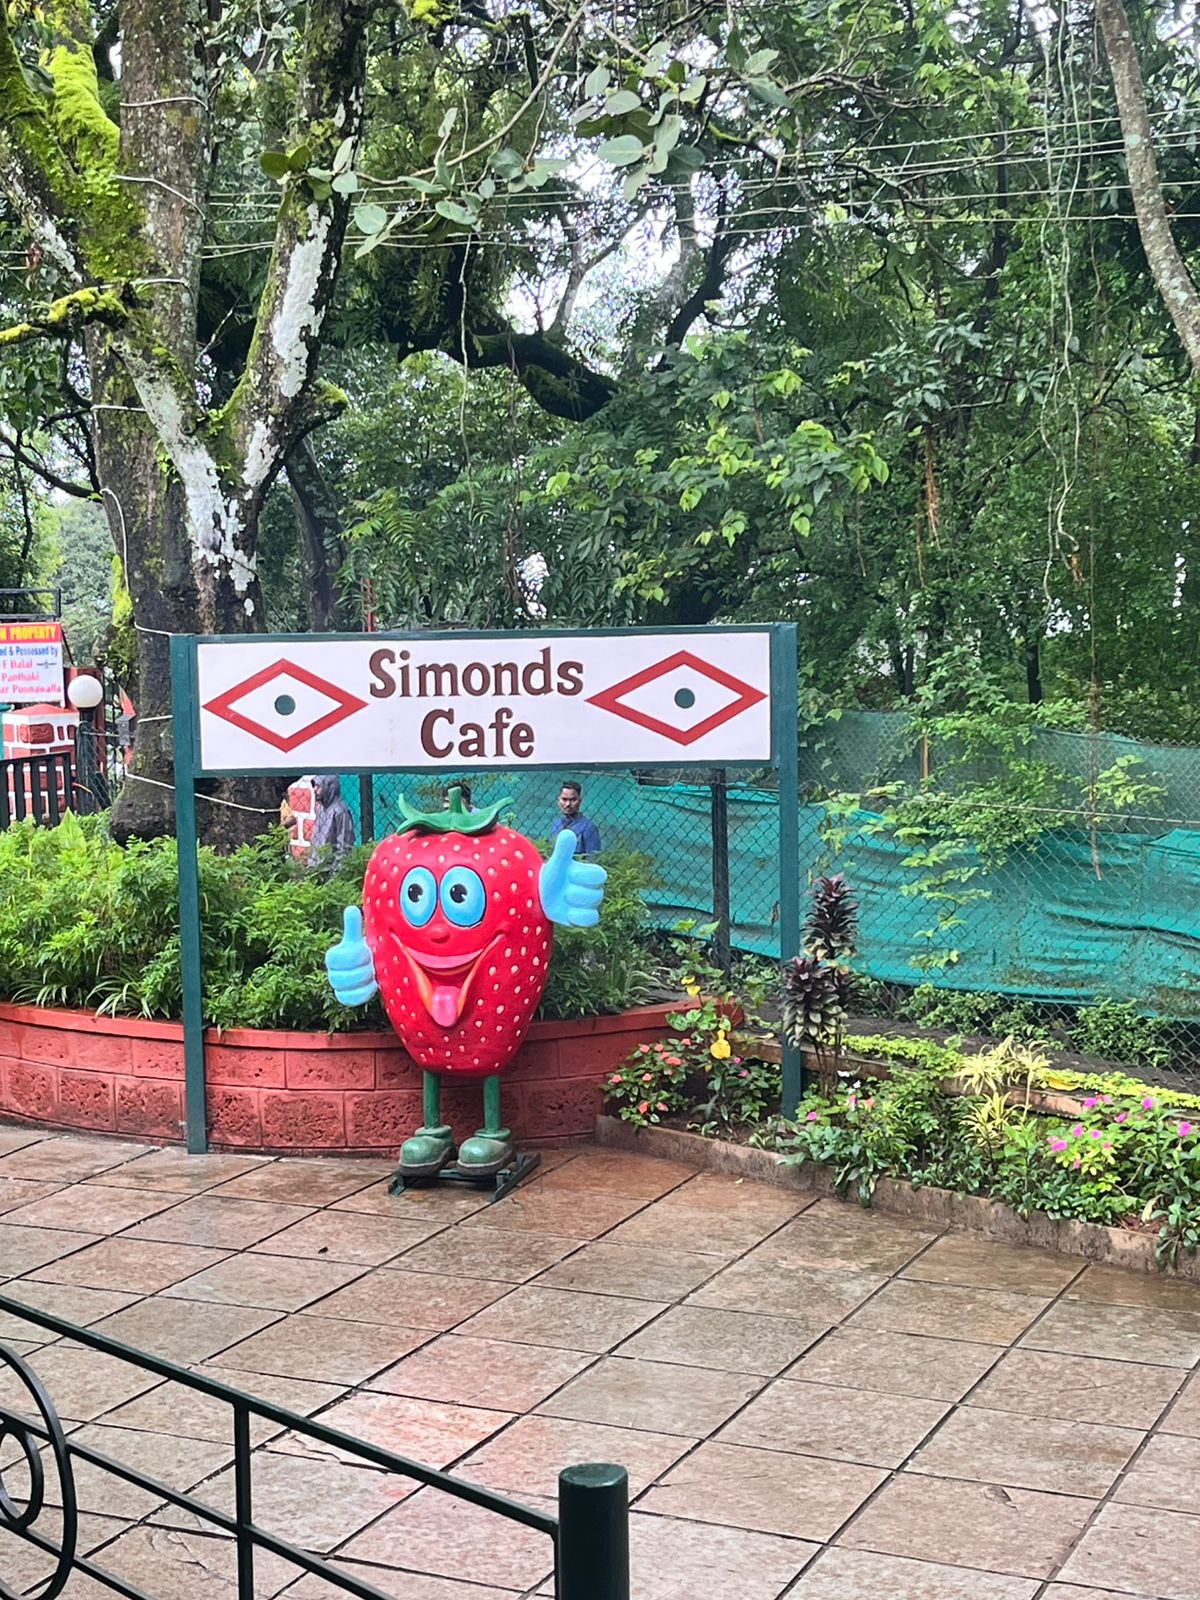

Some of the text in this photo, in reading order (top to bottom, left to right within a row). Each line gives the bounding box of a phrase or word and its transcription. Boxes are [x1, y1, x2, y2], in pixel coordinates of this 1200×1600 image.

[10, 625, 57, 640] PROPERTY
[16, 645, 49, 656] Possessed
[50, 645, 58, 657] by
[11, 659, 33, 669] Dalal
[1, 672, 40, 682] Panthaki
[369, 646, 584, 698] Simonds
[12, 683, 62, 694] Poonawalla
[420, 707, 535, 758] Cafe
